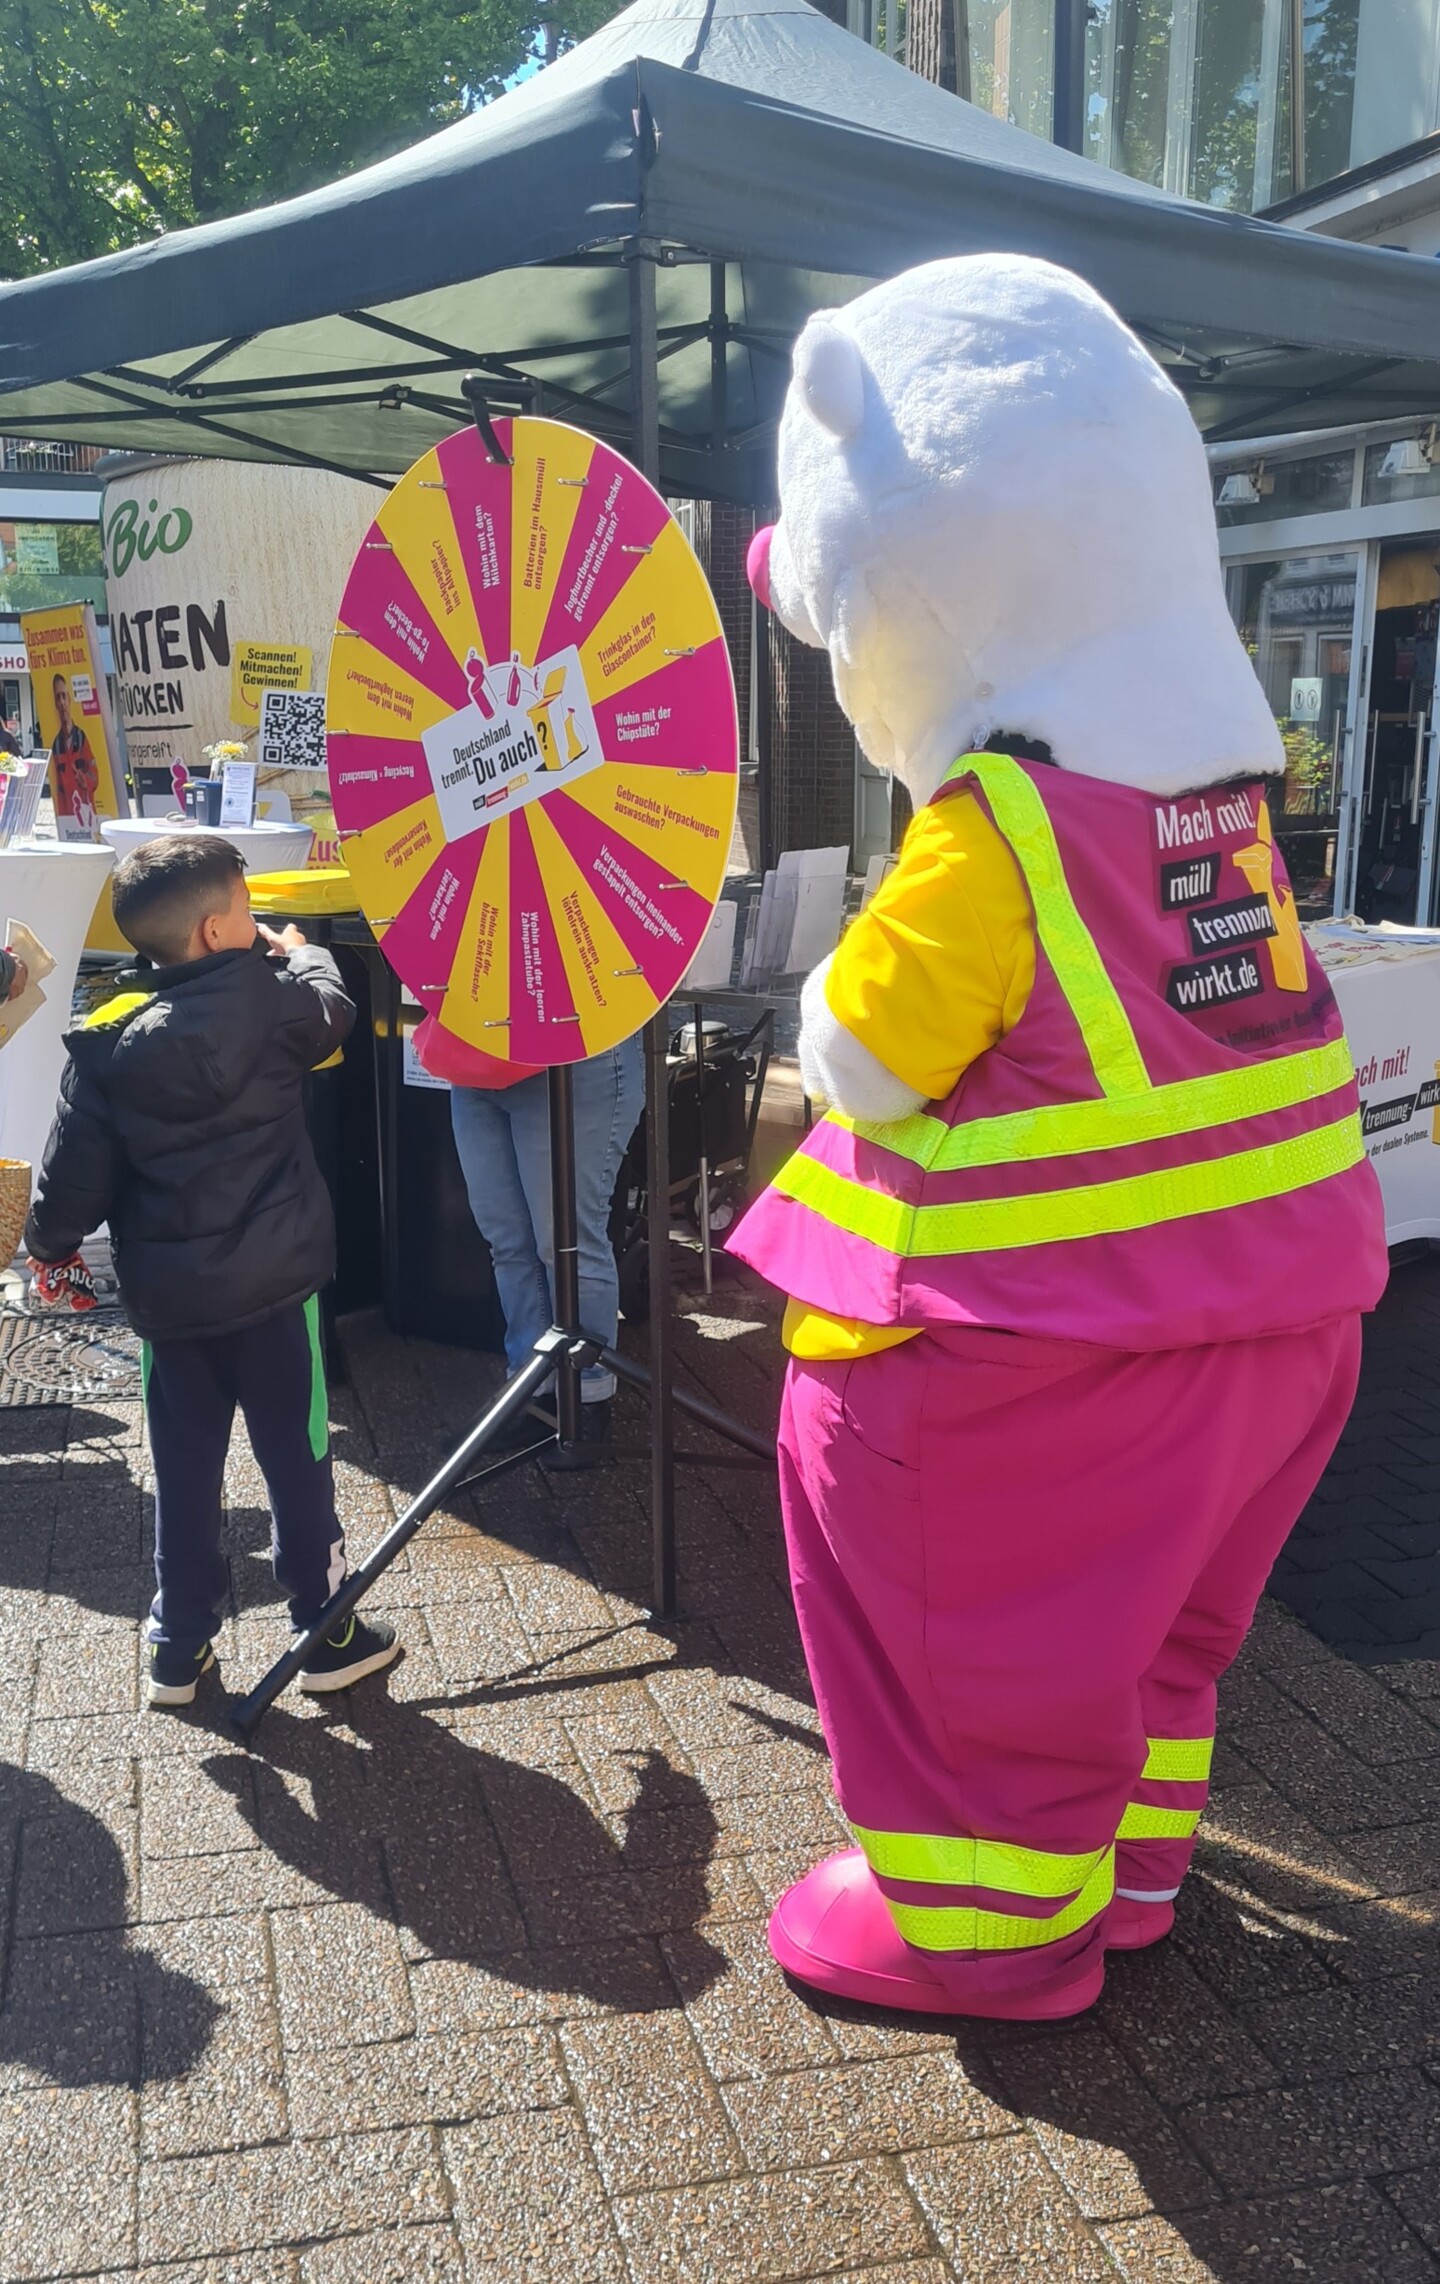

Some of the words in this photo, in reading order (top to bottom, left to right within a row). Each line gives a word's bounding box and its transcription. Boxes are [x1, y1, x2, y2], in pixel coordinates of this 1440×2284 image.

[532, 457, 546, 512] Hausmüll
[475, 504, 485, 528] dem
[530, 516, 539, 530] im
[109, 498, 193, 578] Bio
[477, 531, 486, 551] mit
[484, 512, 500, 586] Milchkarton?
[564, 537, 599, 614] Joghurtbecher
[595, 515, 607, 537] und
[604, 473, 623, 515] -deckel
[432, 539, 455, 591] Altpapier?
[480, 554, 491, 590] Wohin
[523, 533, 538, 588] Batterien
[534, 525, 548, 590] entsorgen?
[573, 575, 596, 622] getrennt
[593, 512, 620, 575] entsorgen?
[430, 559, 454, 615] Backpapier
[452, 591, 461, 608] ins
[384, 610, 398, 630] dem
[396, 624, 408, 641] mit
[25, 627, 68, 647] Zusammen
[69, 624, 84, 640] was
[111, 600, 230, 678] ATEN
[597, 631, 632, 665] Trinkglas
[631, 624, 640, 637] in
[640, 612, 656, 629] den
[29, 650, 46, 669] fürs
[47, 647, 71, 666] Klima
[71, 645, 87, 664] tun.
[247, 648, 297, 663] Scannen!
[407, 638, 425, 664] Wohin
[602, 626, 657, 677] Glascontainer?
[240, 660, 303, 676] Mitmachen!
[243, 673, 298, 688] Gewinnen!
[347, 668, 393, 699] Joghurtbecher?
[367, 691, 380, 706] dem
[382, 698, 392, 710] mit
[393, 703, 412, 722] Wohin
[395, 690, 414, 709] leeren
[616, 711, 640, 726] Wohin
[642, 708, 656, 722] mit
[658, 706, 671, 719] der
[453, 719, 512, 765] Deutschland
[617, 722, 660, 742] Chipstüte?
[441, 762, 474, 789] trennt.
[473, 756, 496, 785] Du
[499, 730, 538, 773] auch
[536, 721, 548, 750] ?
[339, 769, 377, 784] Klimaschutz?
[384, 765, 414, 778] Recycling
[614, 802, 666, 830] auswaschen?
[616, 784, 661, 814] Gebrauchte
[663, 804, 720, 840] Verpackungen
[1155, 799, 1215, 850] Mach
[1216, 790, 1256, 834] mit!
[405, 848, 414, 860] mit
[415, 832, 432, 850] Wohin
[393, 857, 403, 868] der
[428, 869, 453, 921] Eierkarton?
[445, 877, 460, 905] Wohin
[600, 844, 647, 904] Verpackungen
[646, 899, 685, 946] ineinander-
[1170, 861, 1211, 902] müll
[440, 904, 452, 923] mit
[592, 859, 626, 898] gestapelt
[625, 895, 664, 939] entsorgen?
[430, 921, 442, 940] dem
[480, 902, 490, 936] blauen
[488, 906, 499, 938] Wohin
[530, 912, 538, 944] Wohin
[570, 890, 600, 965] Verpackungen
[1192, 904, 1276, 945] trennun
[486, 939, 494, 958] mit
[521, 912, 536, 996] Zahnpastatube?
[533, 946, 541, 966] mit
[561, 896, 582, 945] löffelrein
[579, 946, 607, 1008] auskratzen?
[471, 938, 486, 1002] Sektflasche?
[483, 958, 491, 976] der
[534, 966, 542, 987] der
[1176, 957, 1258, 1005] wirkt.de
[536, 989, 545, 1023] leeren
[1381, 1045, 1411, 1081] mit!
[1366, 1103, 1412, 1130] trennung-
[1371, 1144, 1382, 1157] der
[1382, 1137, 1403, 1152] dualen
[1404, 1129, 1429, 1146] Systeme.
